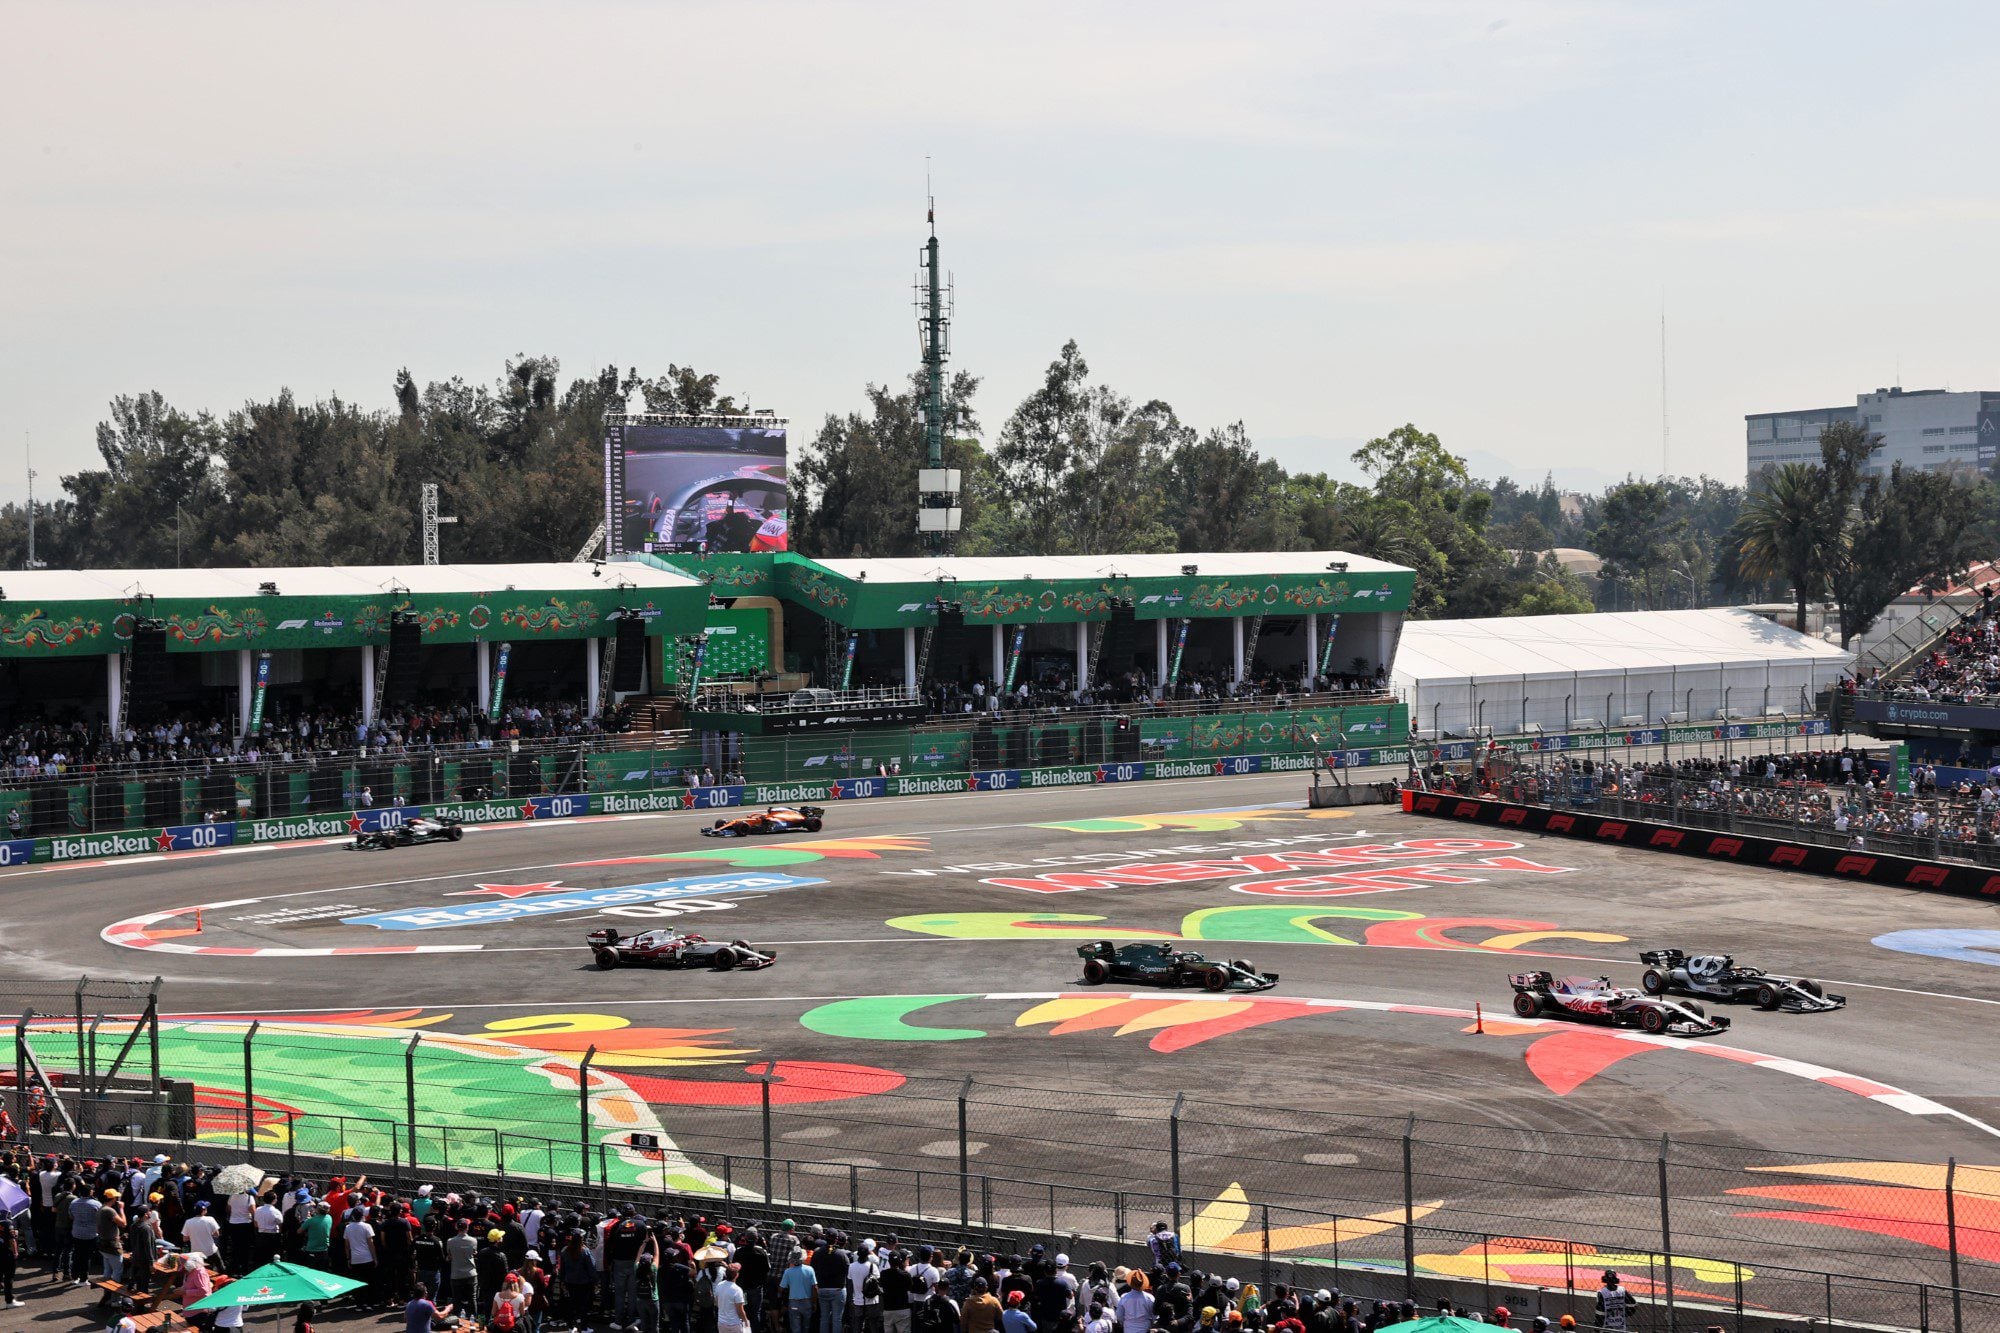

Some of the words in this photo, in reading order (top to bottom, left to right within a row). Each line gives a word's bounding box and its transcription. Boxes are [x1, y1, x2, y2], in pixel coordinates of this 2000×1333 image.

[252, 689, 264, 724] Heineken
[1900, 708, 1948, 720] crypto.com
[1031, 769, 1092, 786] Heineken
[1155, 761, 1211, 778] Heineken
[756, 784, 826, 804] Heineken
[854, 780, 873, 798] 0.0
[898, 776, 963, 794] Heineken
[990, 773, 1007, 789] 0.0
[551, 798, 573, 817] 0.0
[602, 793, 678, 813] Heineken
[709, 788, 728, 807] 0.0
[252, 818, 343, 841] Heineken
[52, 834, 151, 859] Heineken
[192, 826, 216, 848] 0.0
[879, 843, 1237, 876] WELCOME
[1217, 829, 1402, 848] BACK
[978, 838, 1525, 894] MEXICO
[1229, 855, 1581, 897] CITY
[384, 877, 794, 927] Heineken
[1564, 997, 1604, 1016] HAAS
[236, 1292, 286, 1303] Heineken
